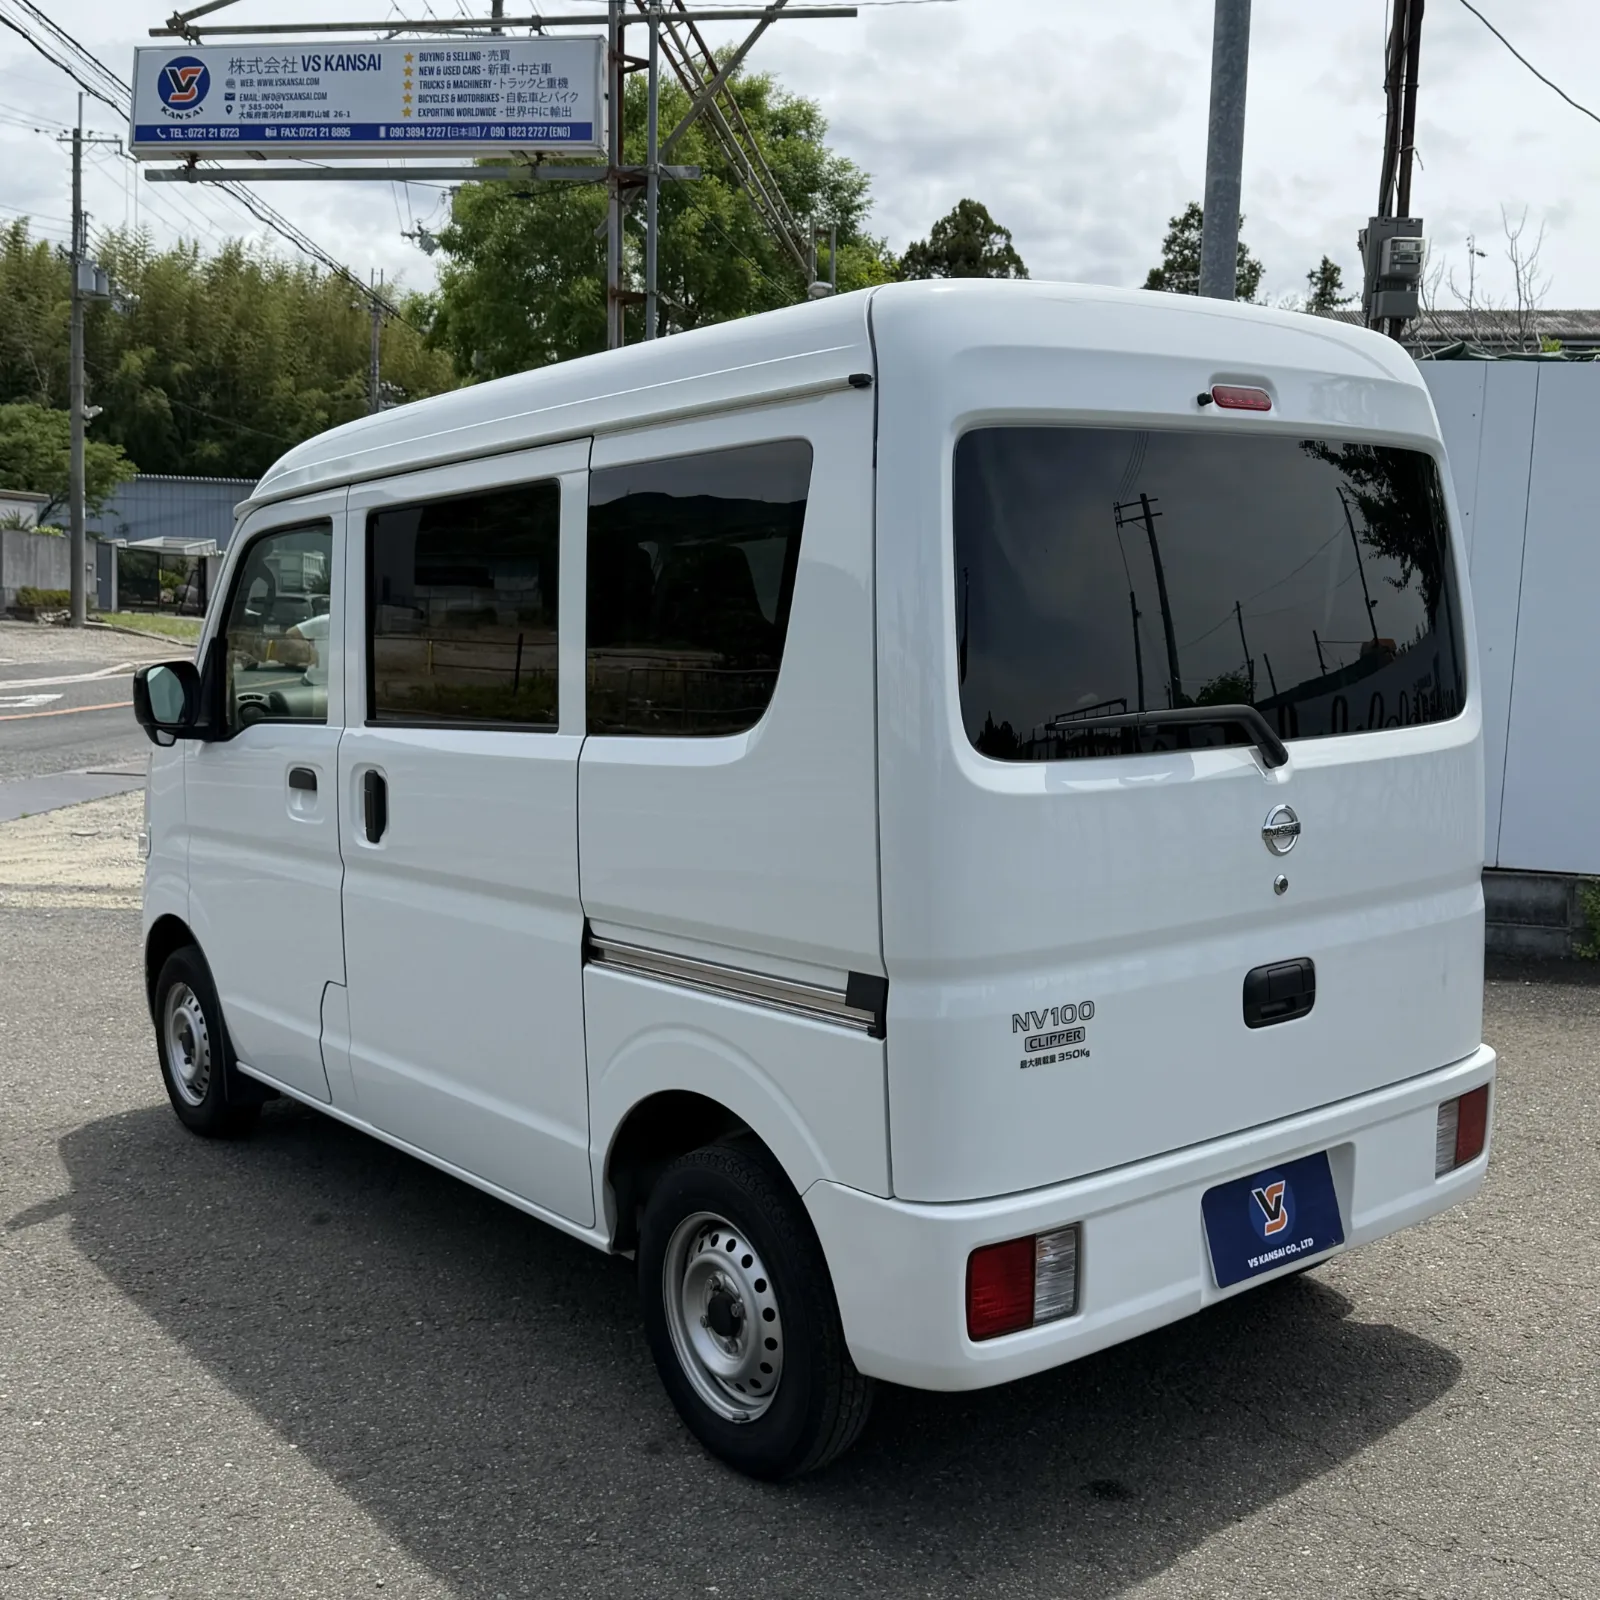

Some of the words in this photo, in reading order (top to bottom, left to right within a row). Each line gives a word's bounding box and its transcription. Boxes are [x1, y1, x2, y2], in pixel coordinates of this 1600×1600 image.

[419, 52, 445, 62] BUYING
[446, 52, 451, 61] &
[453, 51, 481, 61] SELLING
[488, 49, 511, 62] 売買
[228, 55, 298, 76] 株式会社
[301, 54, 322, 73] VS
[324, 53, 382, 72] KANSAI
[418, 66, 435, 76] NEW
[436, 66, 441, 75] &
[443, 65, 461, 76] USED
[462, 65, 481, 75] CARS
[488, 62, 552, 76] 新車・中古車
[164, 66, 205, 103] VS
[240, 78, 256, 88] WEB:
[257, 77, 320, 88] WWW.VSKANSAI.COM
[419, 80, 445, 89] TRUCKS
[446, 80, 451, 89] &
[453, 79, 492, 89] MACHINERY
[500, 77, 569, 89] トラックと重機
[239, 93, 261, 102] EMAIL:
[261, 91, 328, 101] INFO@VSKANSAI.COM
[418, 93, 450, 103] BICYCLES
[451, 93, 456, 103] &
[457, 92, 500, 103] MOTORBIKES
[506, 91, 579, 103] 自転車とバイク
[160, 105, 204, 120] KANSAI
[248, 103, 284, 111] 585-0004
[418, 107, 455, 117] EXPORTING
[456, 106, 497, 117] WORLDWIDE
[505, 105, 572, 118] 世界中に輸出
[333, 110, 351, 118] 26-1
[208, 127, 218, 138] 21
[220, 127, 240, 138] 8723
[320, 127, 329, 137] 21
[331, 127, 351, 137] 8895
[389, 126, 405, 137] 090
[406, 126, 425, 137] 3894
[427, 126, 446, 137] 2727
[490, 126, 505, 137] 090
[508, 126, 526, 138] 1823
[528, 126, 548, 137] 2727
[549, 126, 571, 138] (ENG)
[1011, 1000, 1095, 1034] NV100
[1029, 1030, 1082, 1049] CLIPPER
[1057, 1048, 1090, 1062] 350Kg
[1251, 1179, 1288, 1237] VS
[1247, 1256, 1259, 1269] VS
[1258, 1247, 1286, 1265] KANSAI
[1286, 1243, 1301, 1255] CO.,
[1300, 1237, 1314, 1250] LTD
